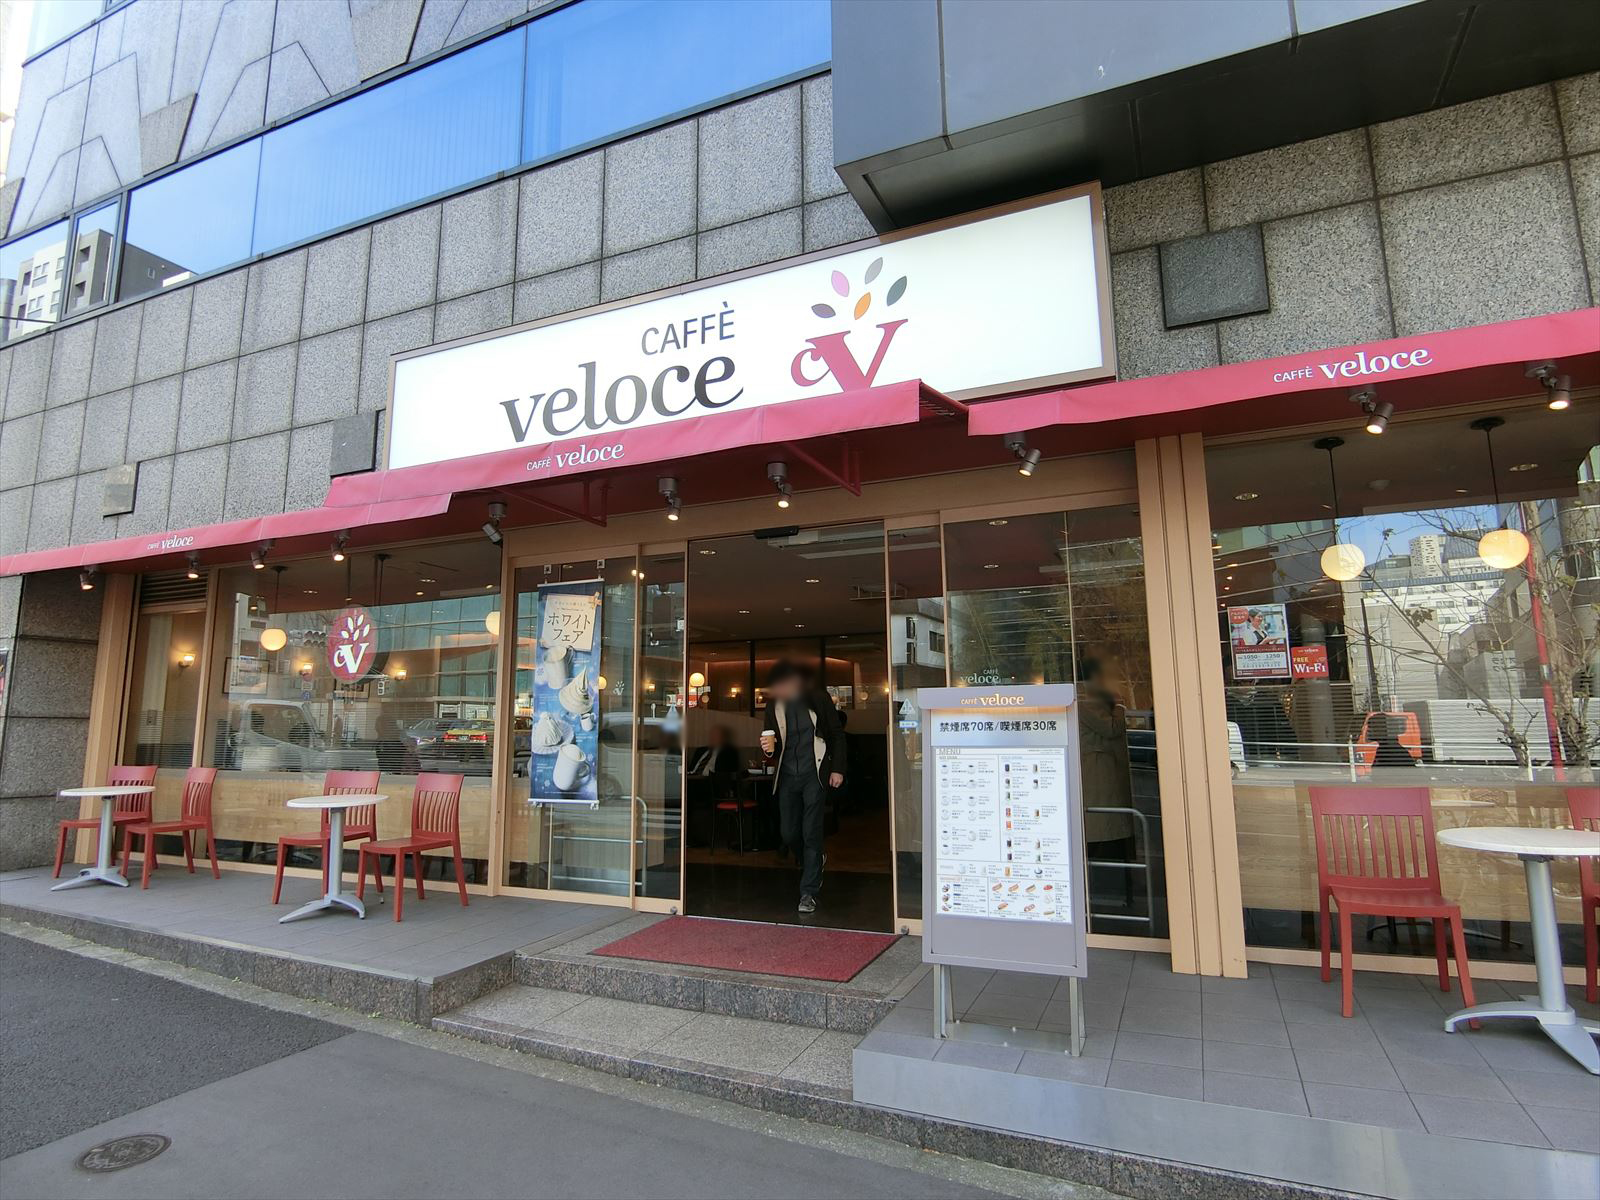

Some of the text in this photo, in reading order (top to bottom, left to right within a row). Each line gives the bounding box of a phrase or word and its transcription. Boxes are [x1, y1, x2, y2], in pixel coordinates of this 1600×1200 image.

[641, 301, 735, 356] CAFFÈ
[1273, 349, 1433, 383] CAFFÈ veloce
[499, 356, 744, 442] veloce
[526, 443, 625, 471] CAFFÈ veloce
[161, 535, 194, 549] veloce
[547, 612, 591, 630] ホワイト
[553, 628, 584, 643] フェア
[960, 672, 1000, 685] veloce
[980, 694, 1025, 706] veloce
[939, 720, 1057, 733] 禁煙席70席/喫煙席30席
